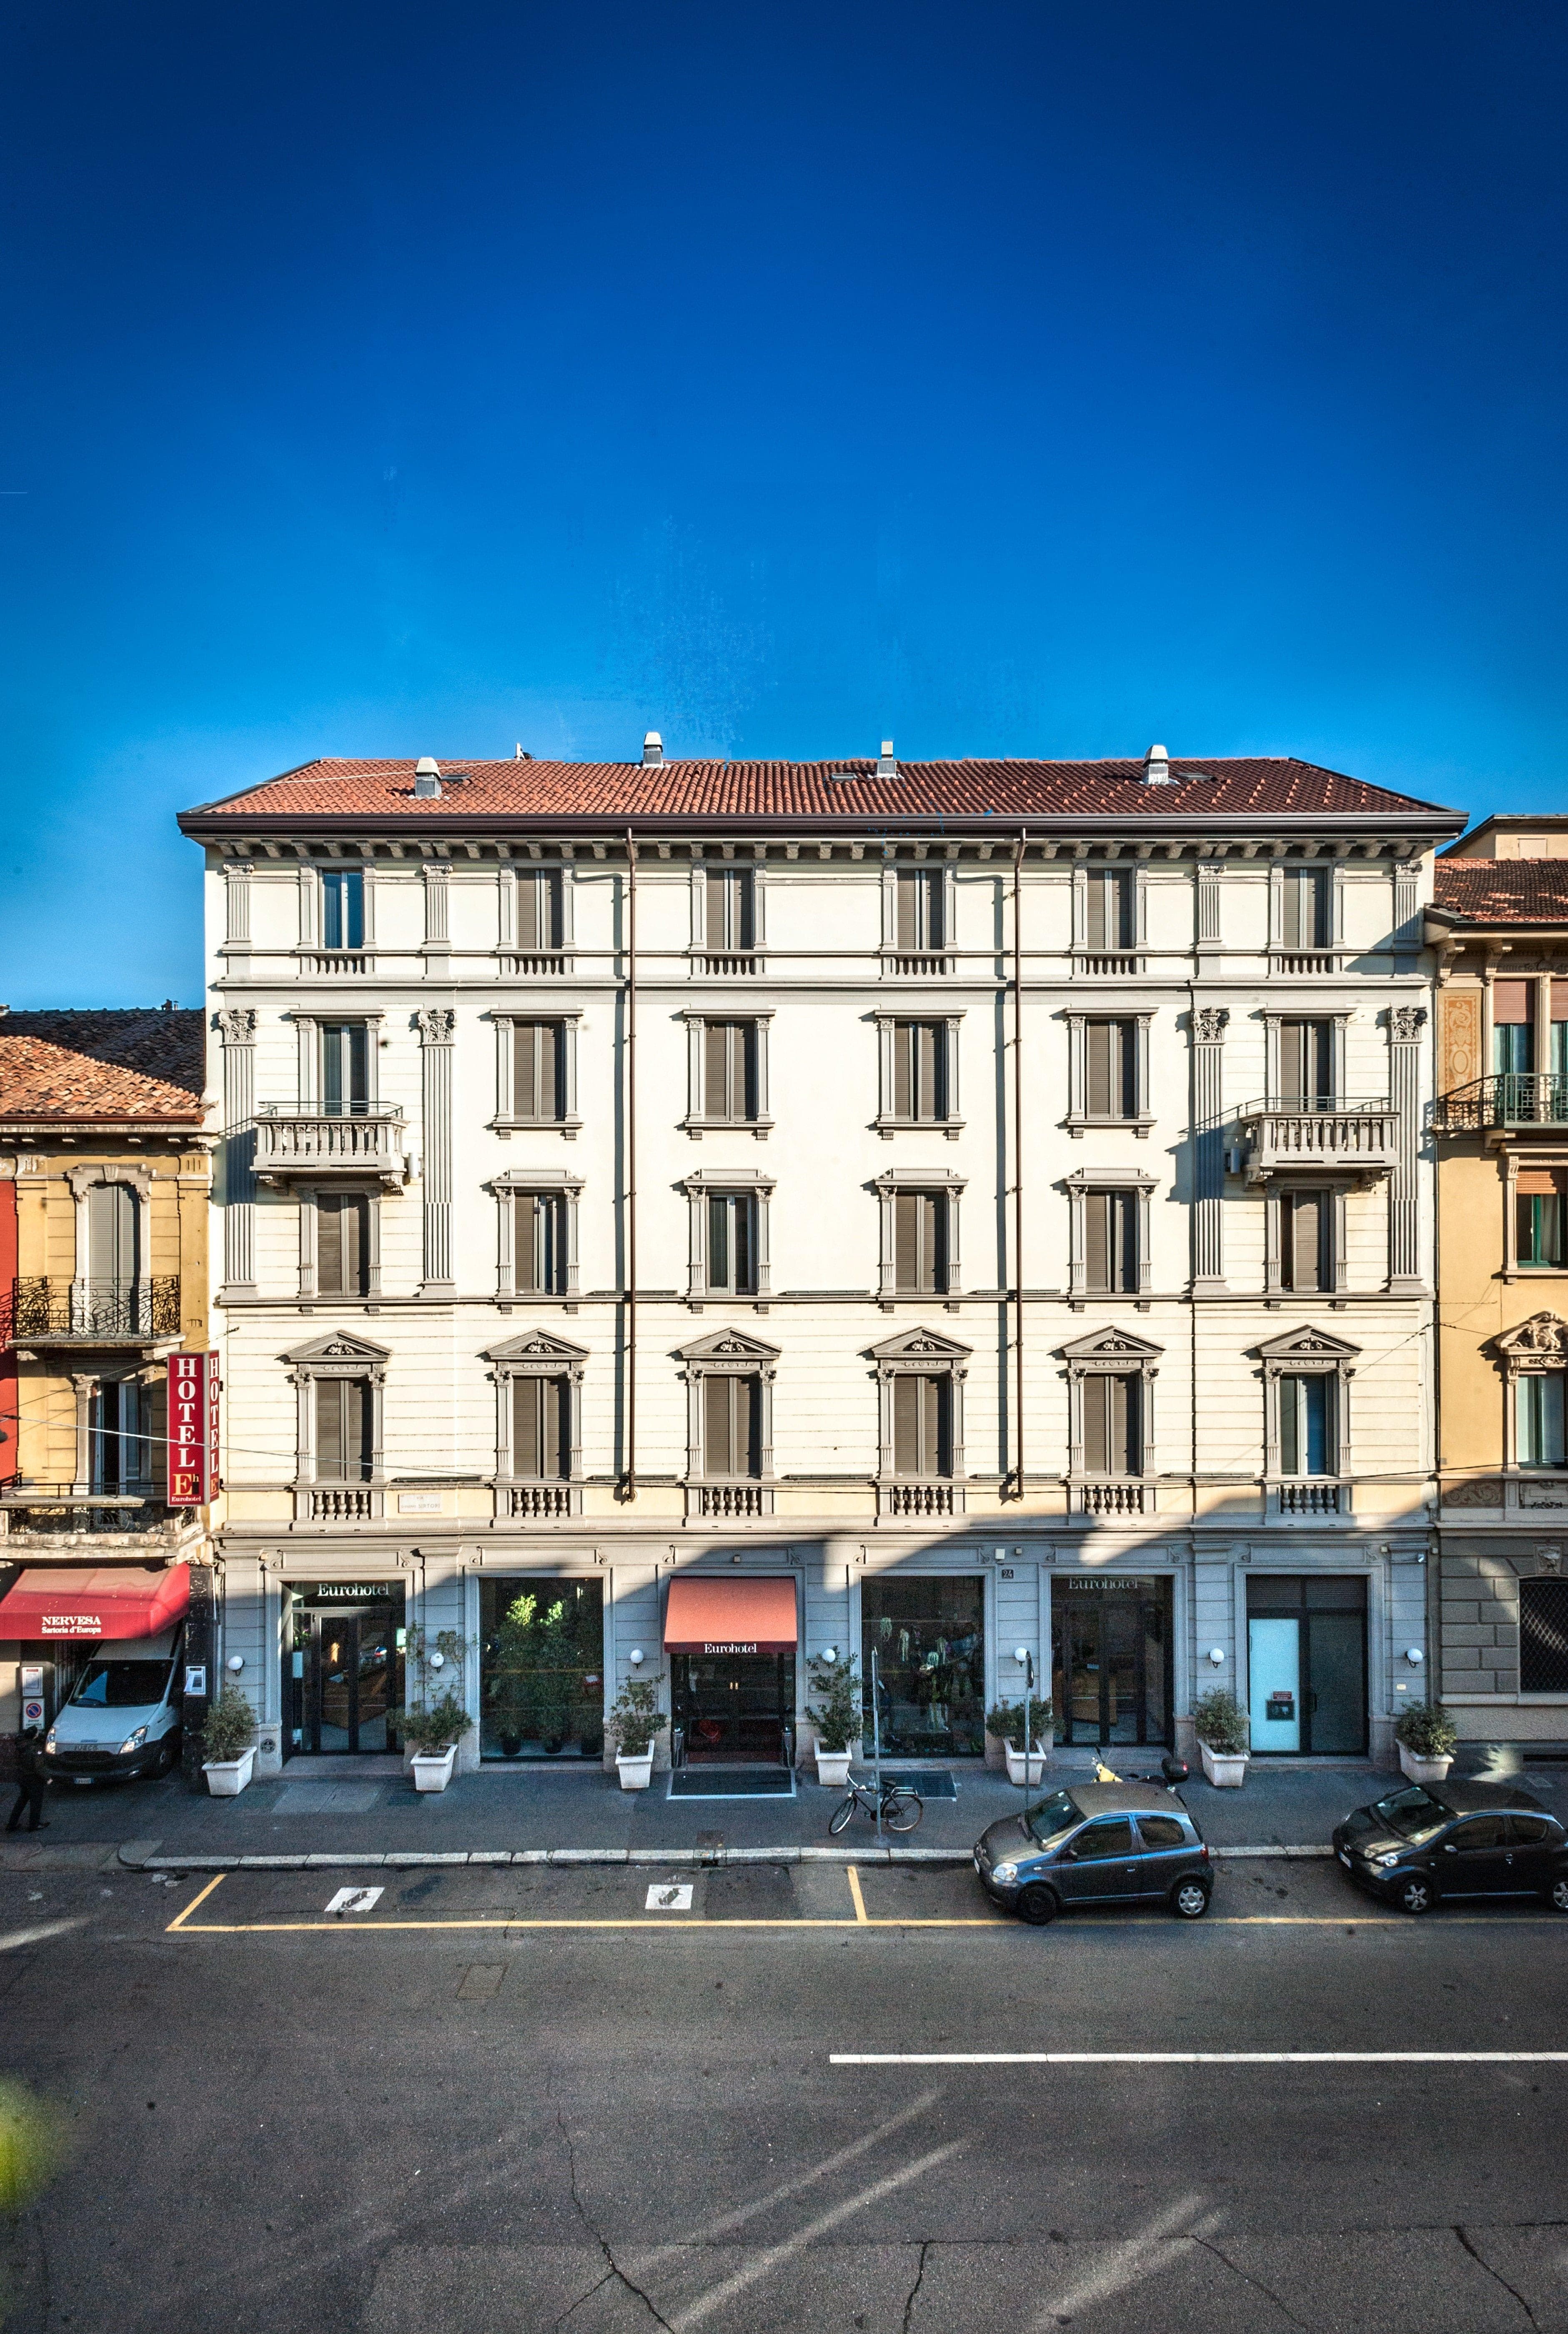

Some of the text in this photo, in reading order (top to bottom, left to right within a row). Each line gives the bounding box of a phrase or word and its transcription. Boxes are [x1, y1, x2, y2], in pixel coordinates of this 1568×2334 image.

[177, 1358, 197, 1467] HOTEL
[210, 1357, 218, 1474] HOTEL
[1068, 1577, 1138, 1589] Eurohotel
[317, 1583, 389, 1596] Eurohotel
[42, 1616, 102, 1625] NERVESA
[70, 1626, 102, 1634] d'Europa
[704, 1643, 757, 1653] Eurohotel
